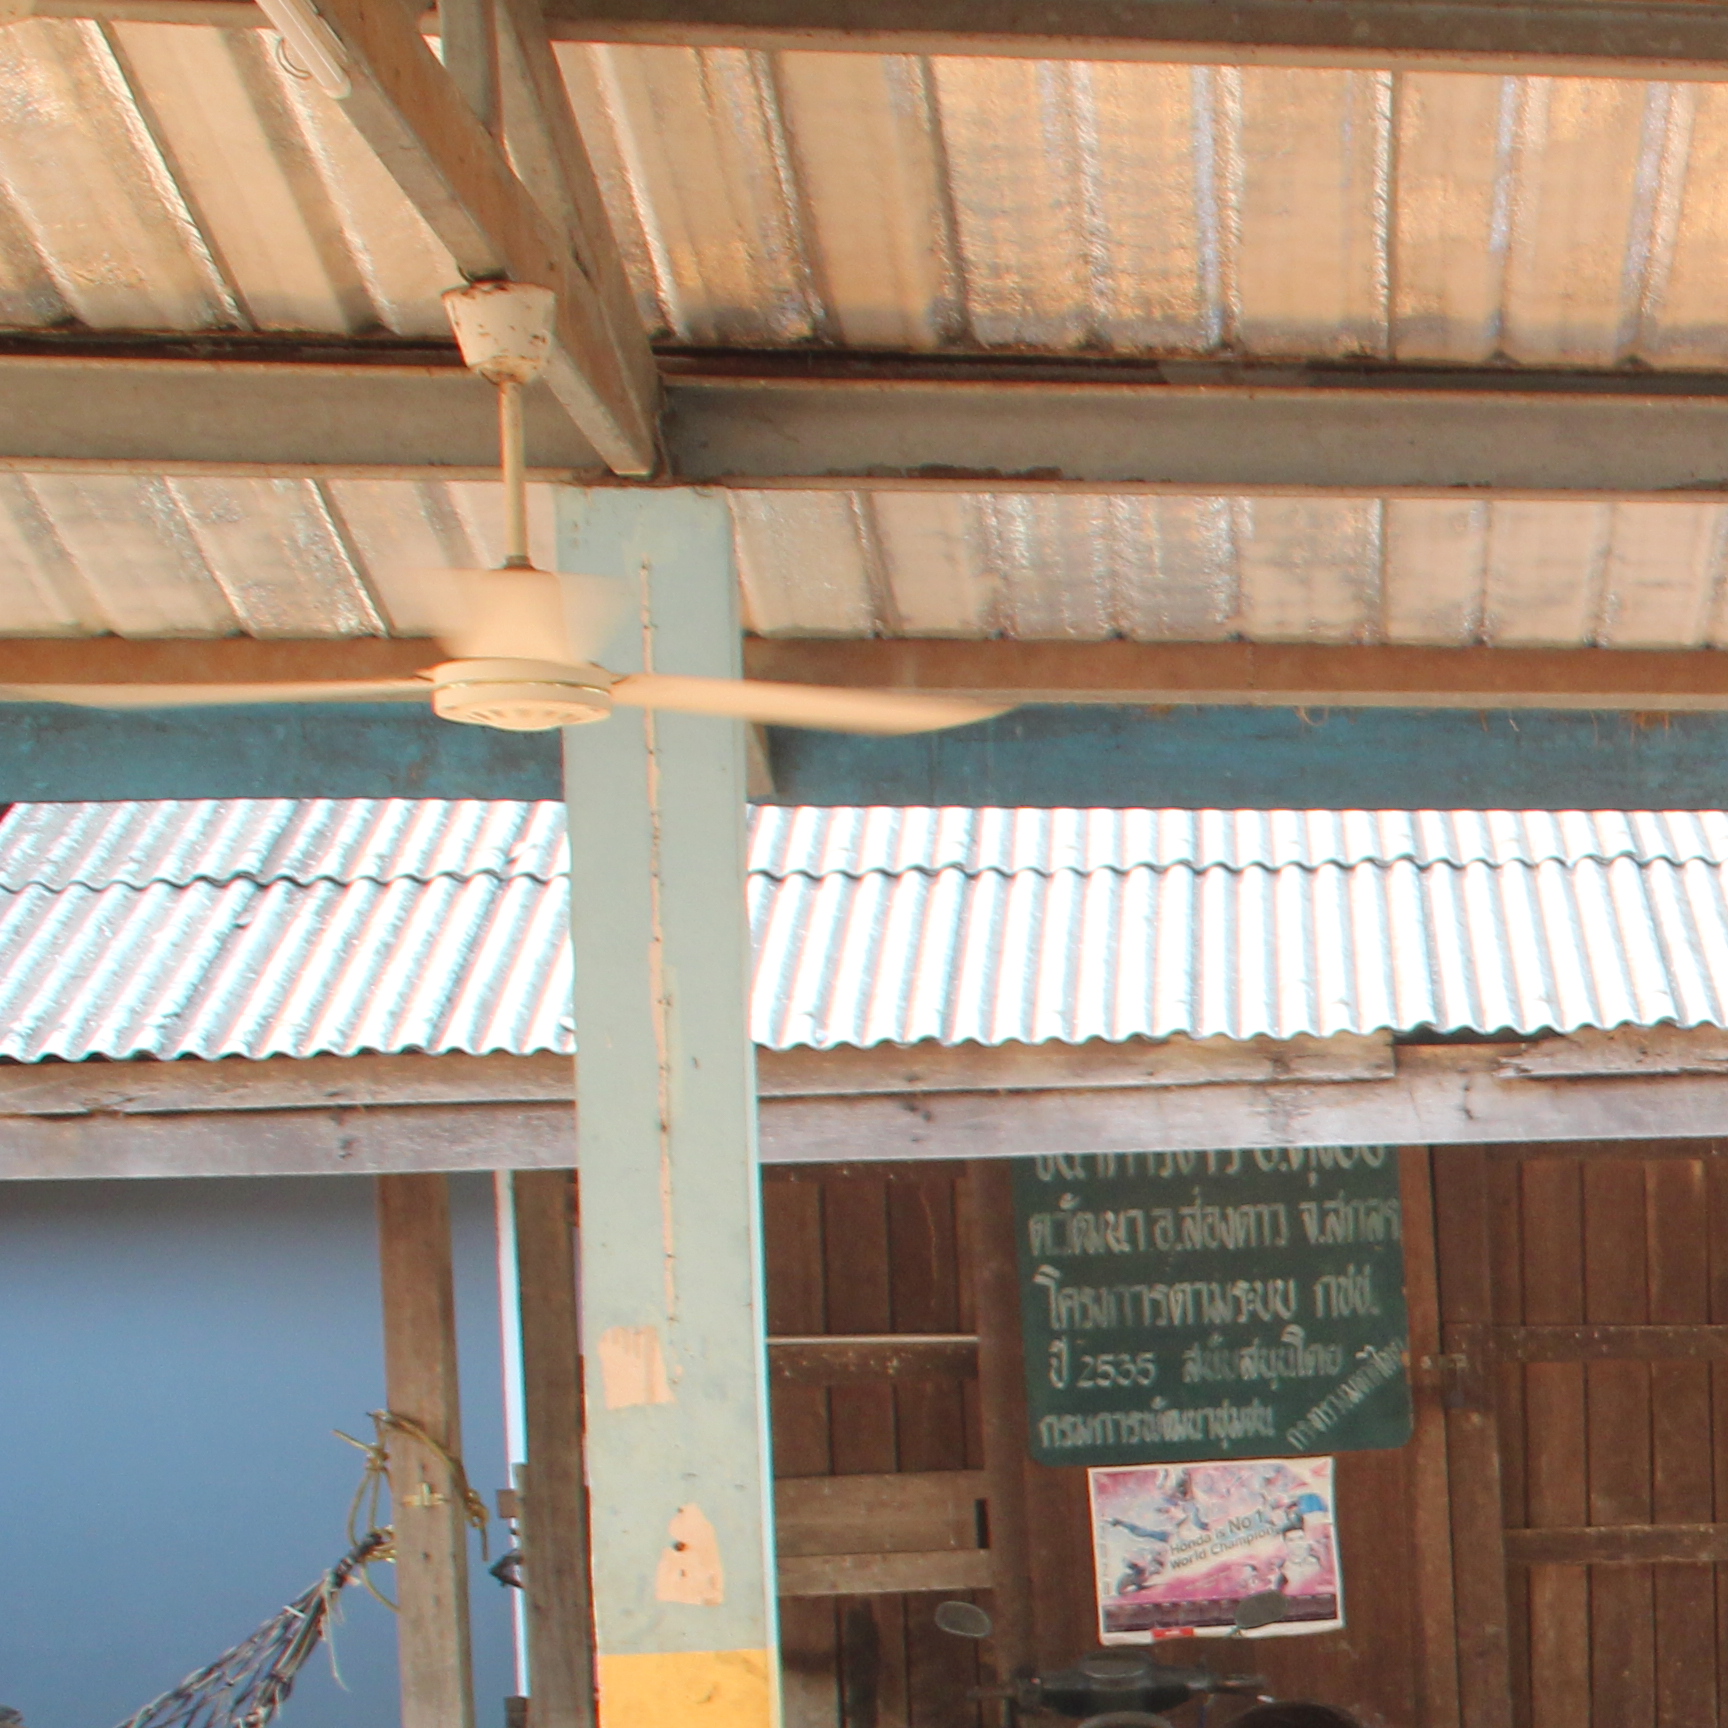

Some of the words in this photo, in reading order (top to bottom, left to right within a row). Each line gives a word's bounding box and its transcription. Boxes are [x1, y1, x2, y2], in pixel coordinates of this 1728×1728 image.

[1032, 1264, 1299, 1331] โครงการตามระบบ
[1075, 1350, 1157, 1388] 2535
[1170, 1532, 1212, 1554] Honda
[1215, 1528, 1226, 1540] is
[1228, 1516, 1252, 1534] No
[1170, 1549, 1207, 1570] World
